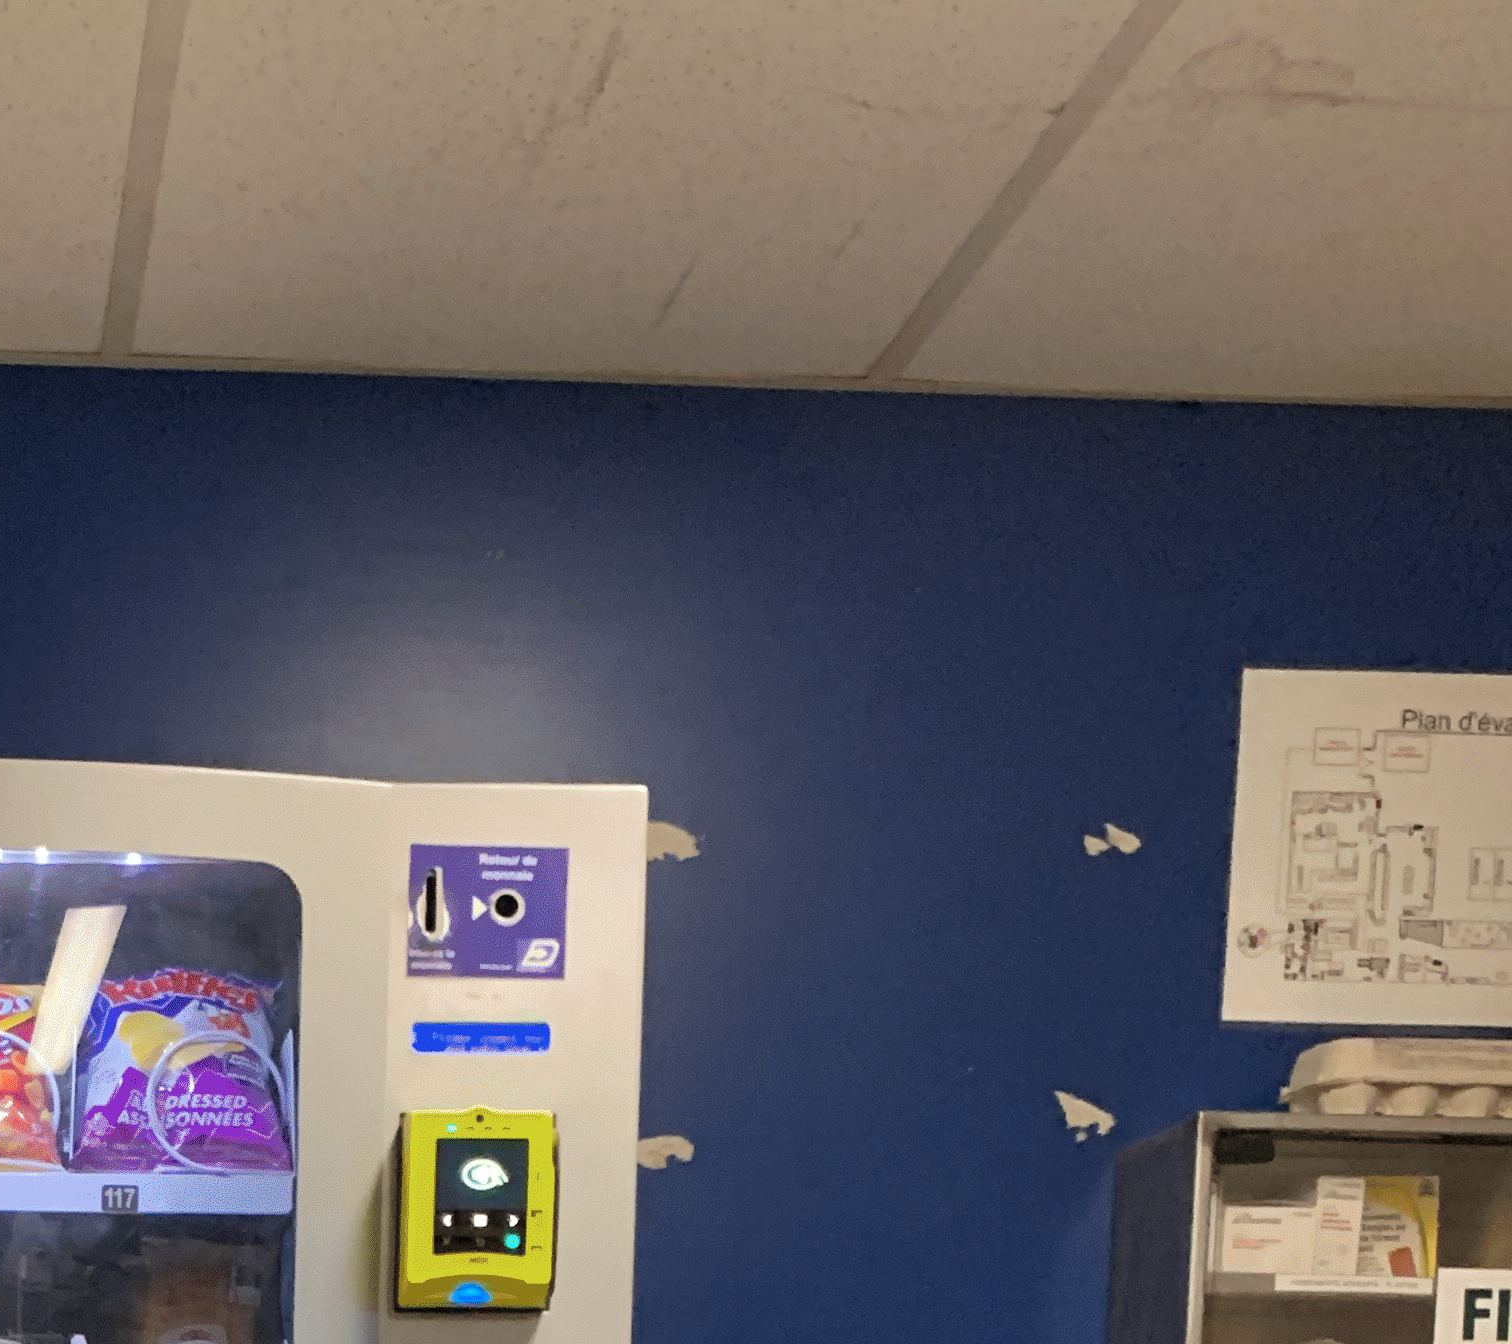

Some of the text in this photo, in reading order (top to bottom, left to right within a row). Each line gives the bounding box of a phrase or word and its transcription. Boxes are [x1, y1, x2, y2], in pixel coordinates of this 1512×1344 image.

[1401, 708, 1451, 730] Plan
[165, 1093, 248, 1110] DRESSED
[104, 1187, 138, 1208] 117
